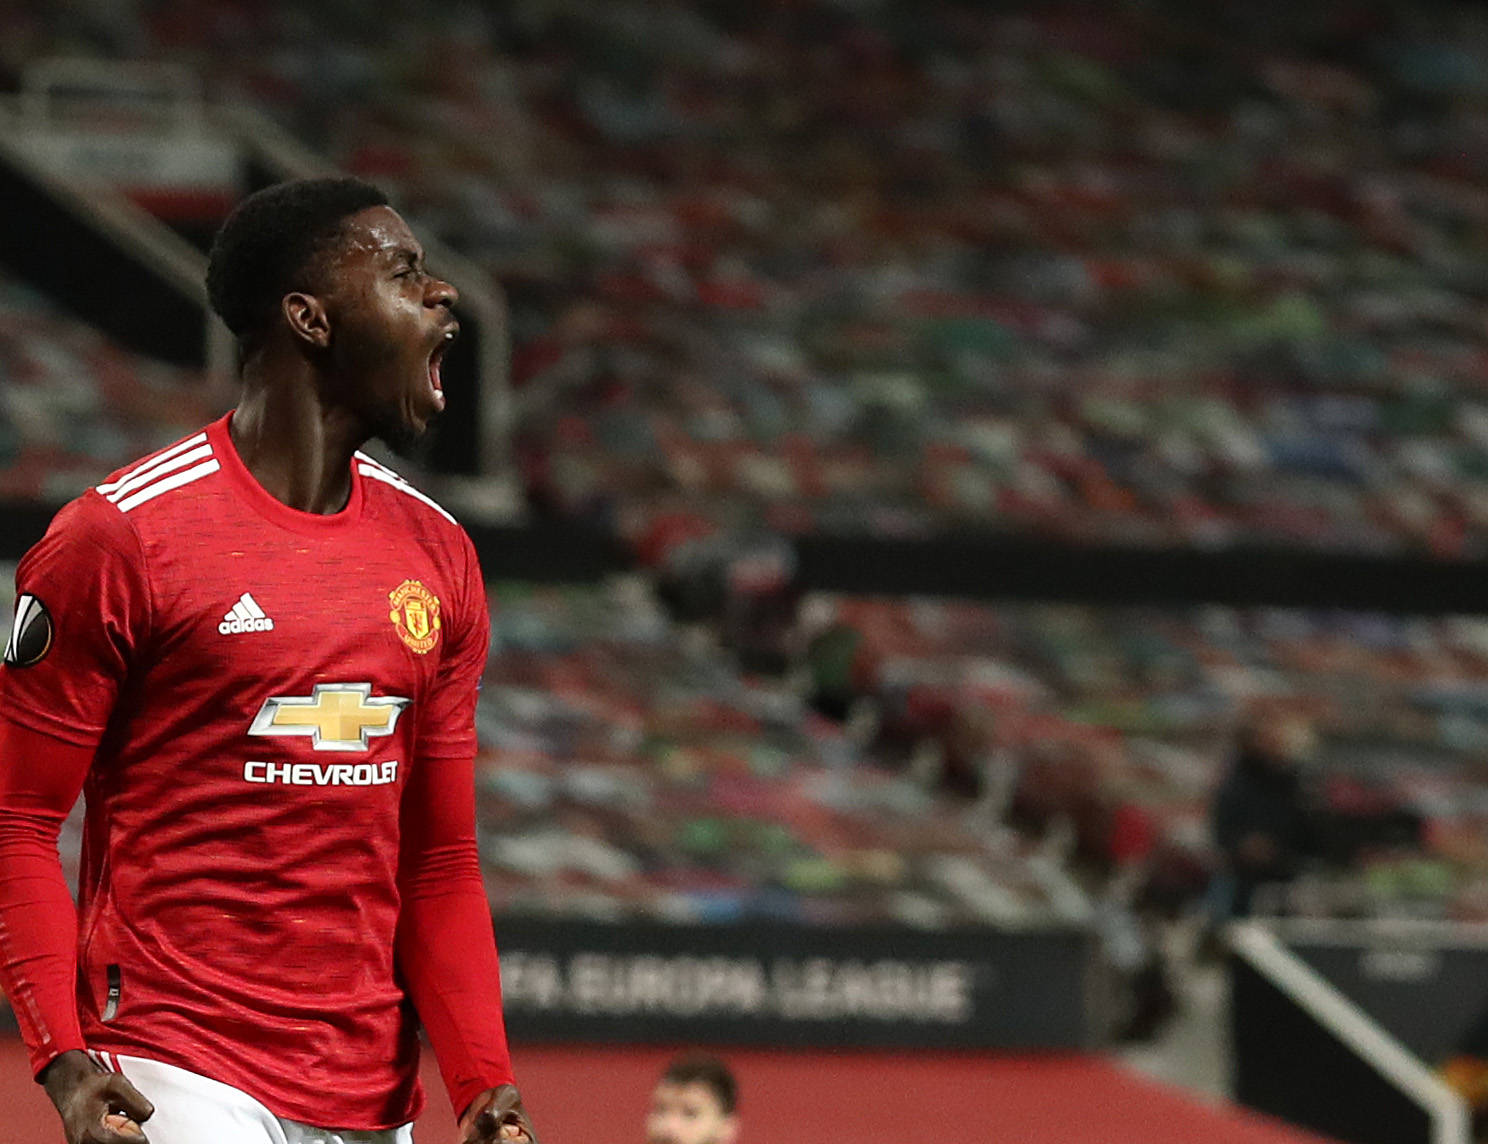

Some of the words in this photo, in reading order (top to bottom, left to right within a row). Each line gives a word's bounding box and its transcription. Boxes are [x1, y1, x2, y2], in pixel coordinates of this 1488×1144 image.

[218, 617, 274, 635] adidas
[244, 760, 398, 786] CHEVROLET
[568, 953, 764, 1016] EUROPA
[768, 957, 974, 1023] LEAGUE
